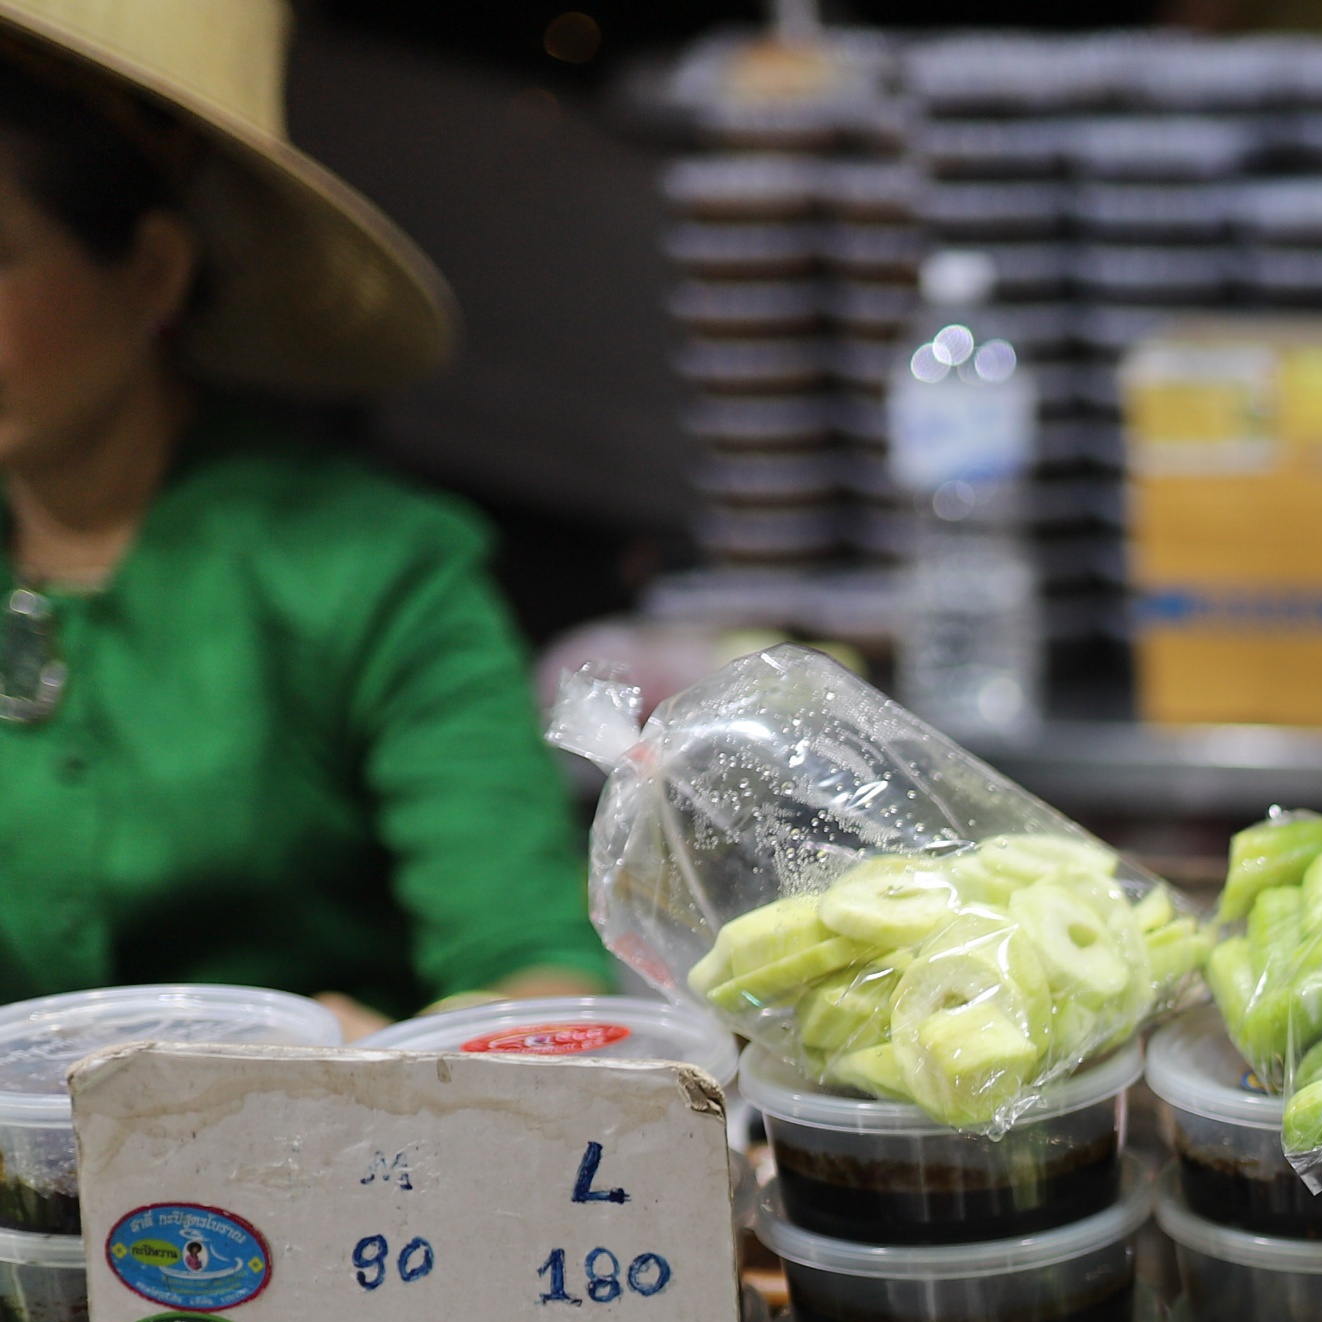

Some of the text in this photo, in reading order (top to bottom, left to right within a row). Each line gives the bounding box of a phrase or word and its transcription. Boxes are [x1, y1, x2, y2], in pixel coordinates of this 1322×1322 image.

[572, 1141, 630, 1203] L
[352, 1233, 435, 1291] 90
[535, 1246, 671, 1306] 180
